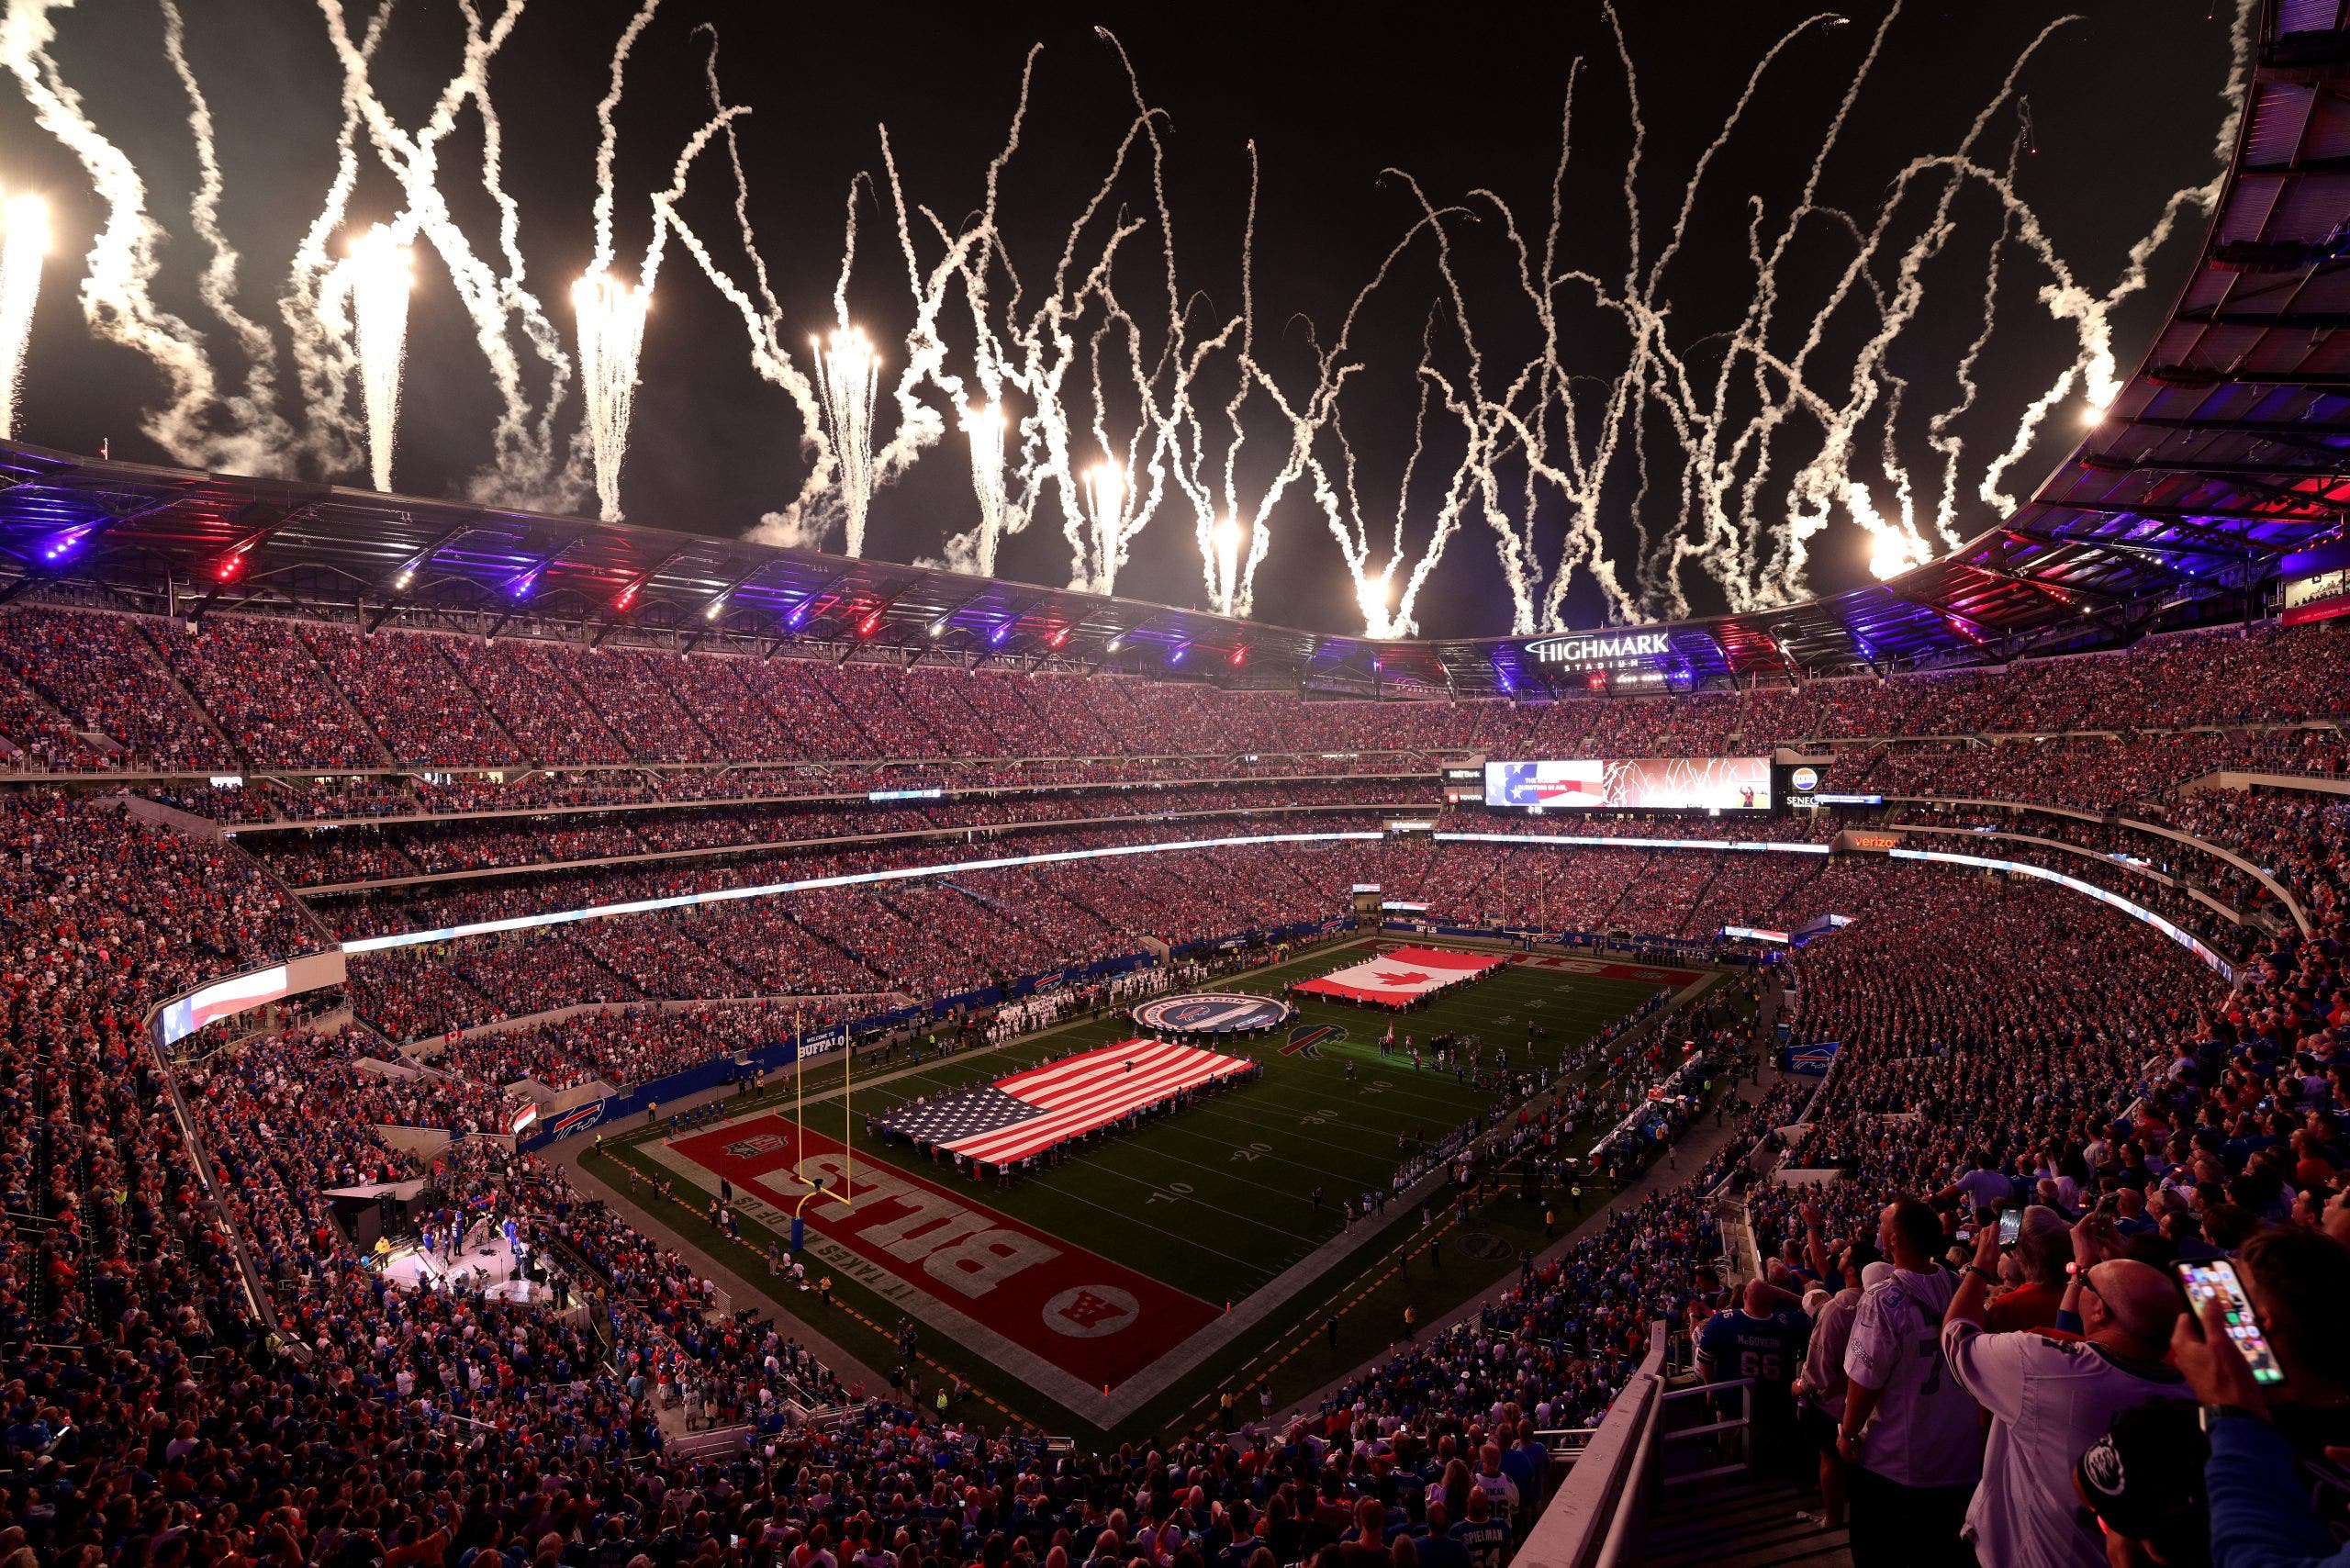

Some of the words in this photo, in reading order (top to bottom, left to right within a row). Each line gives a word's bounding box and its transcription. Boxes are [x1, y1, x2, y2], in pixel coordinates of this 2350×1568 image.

[1539, 633, 1669, 663] HIGHMARK
[1564, 659, 1639, 672] STADIUM
[1416, 924, 1437, 934] BILS
[1181, 996, 1247, 1005] SEASON
[799, 1035, 845, 1058] BUFFALO
[1228, 1142, 1273, 1161] 20
[1146, 1182, 1194, 1204] 10
[752, 1153, 1064, 1300] BILLS
[817, 1245, 886, 1283] TAKES
[880, 1282, 916, 1302] IT
[1740, 1350, 1783, 1382] 66
[1462, 1529, 1504, 1545] SPIELMAN
